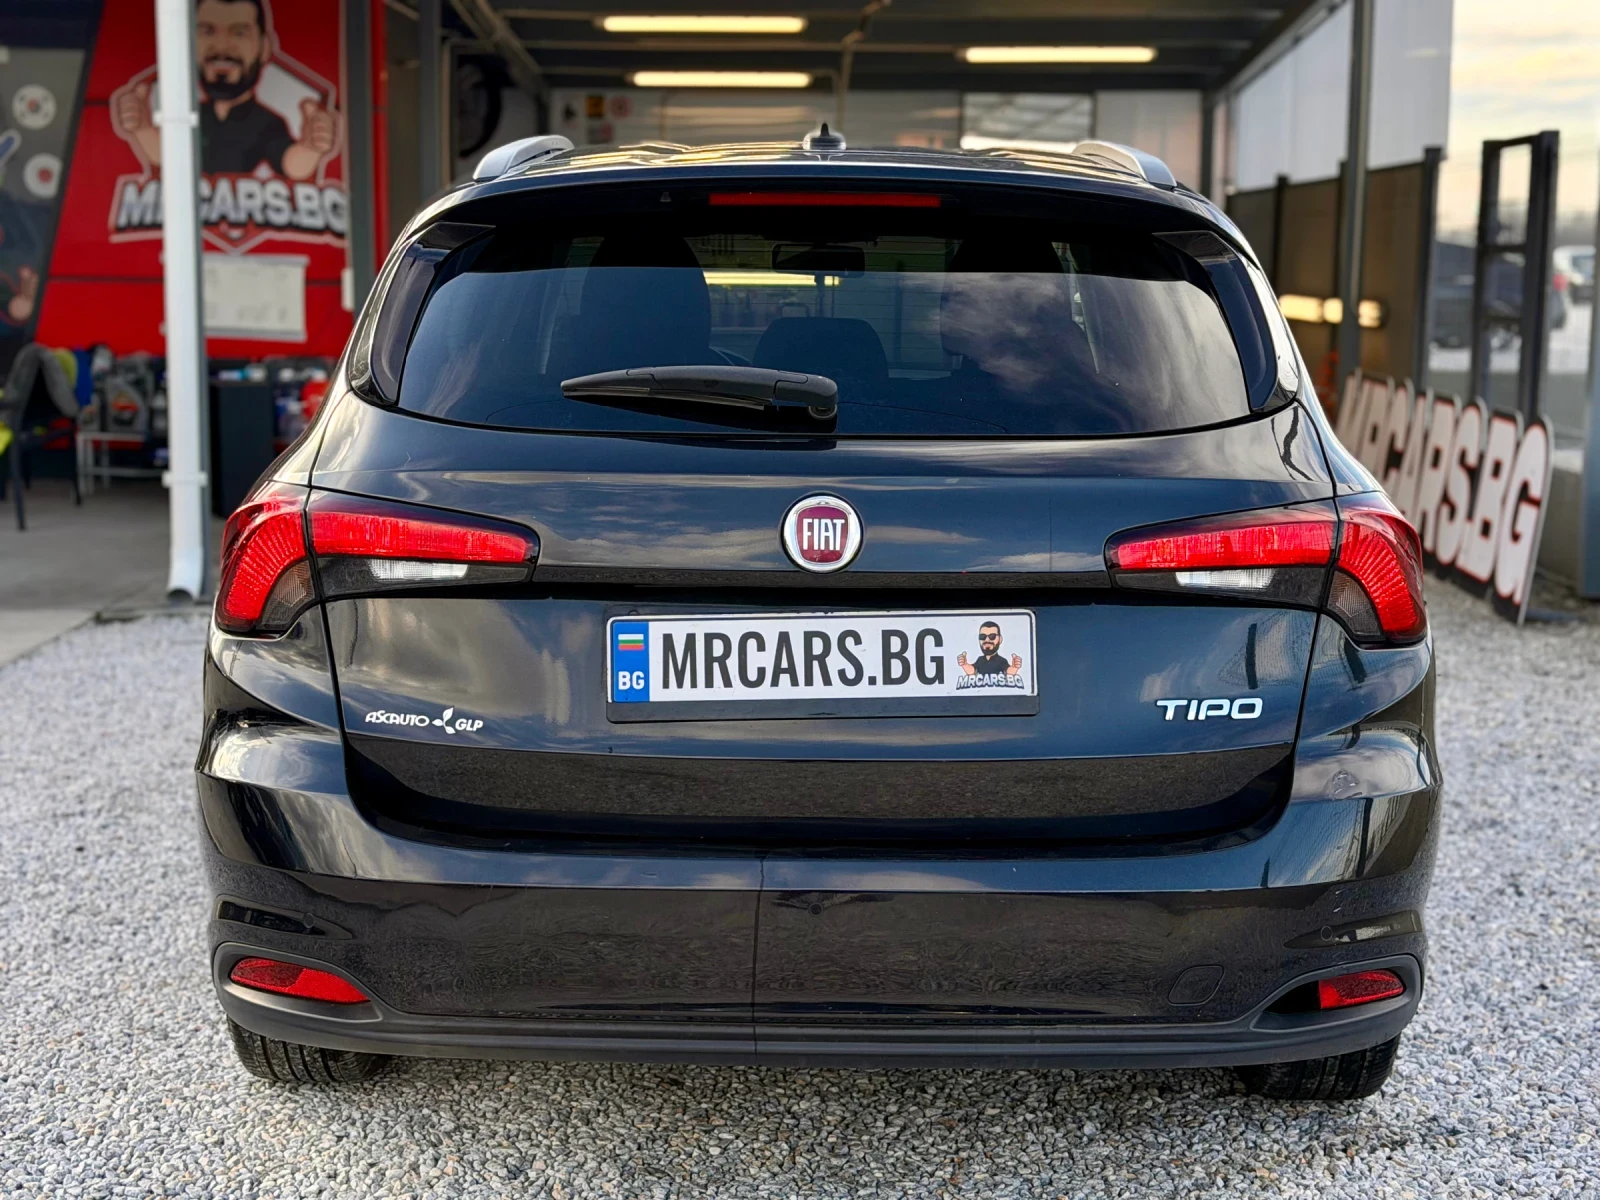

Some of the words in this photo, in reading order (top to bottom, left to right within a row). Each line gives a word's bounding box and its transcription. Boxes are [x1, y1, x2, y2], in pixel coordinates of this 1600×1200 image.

[116, 177, 349, 234] MARS.BG
[802, 518, 845, 551] FIAT
[662, 628, 945, 690] MRCARS.BG
[618, 671, 645, 690] BG
[956, 673, 1025, 690] MRCARS.BG
[1156, 698, 1263, 721] TIPO
[455, 718, 484, 732] GLP
